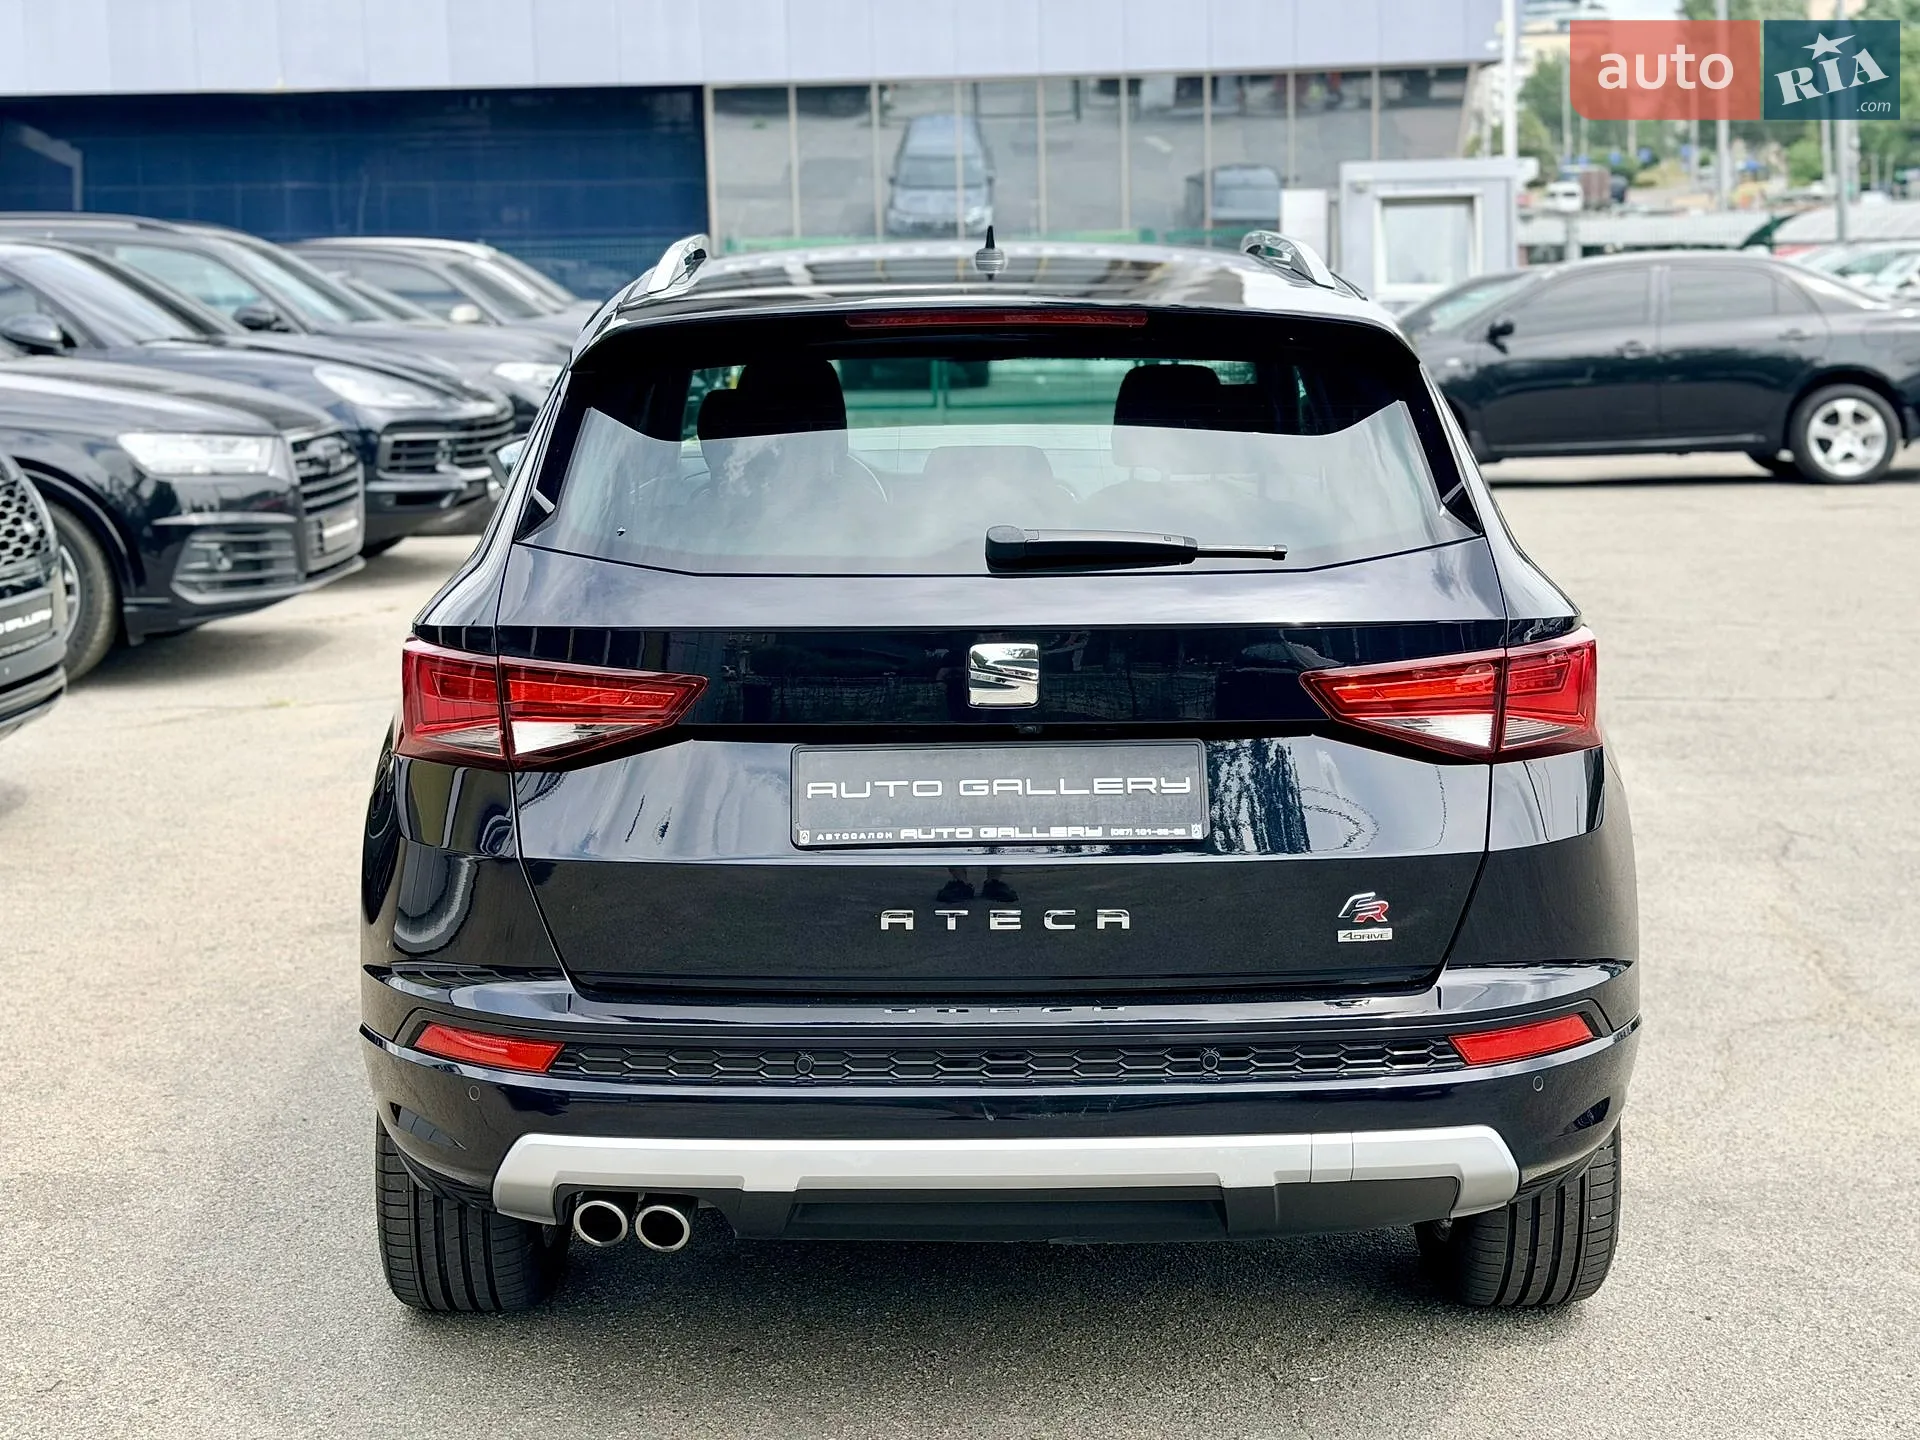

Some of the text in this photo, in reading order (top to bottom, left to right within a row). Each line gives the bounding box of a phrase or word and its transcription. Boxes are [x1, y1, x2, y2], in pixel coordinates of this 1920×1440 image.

[806, 776, 1191, 799] AUTO GALLERY
[899, 827, 973, 842] AUTO
[979, 826, 1105, 842] GALLERY
[1337, 891, 1390, 923] FR
[879, 908, 1131, 931] ATECA
[1342, 931, 1389, 941] 4DRIVE
